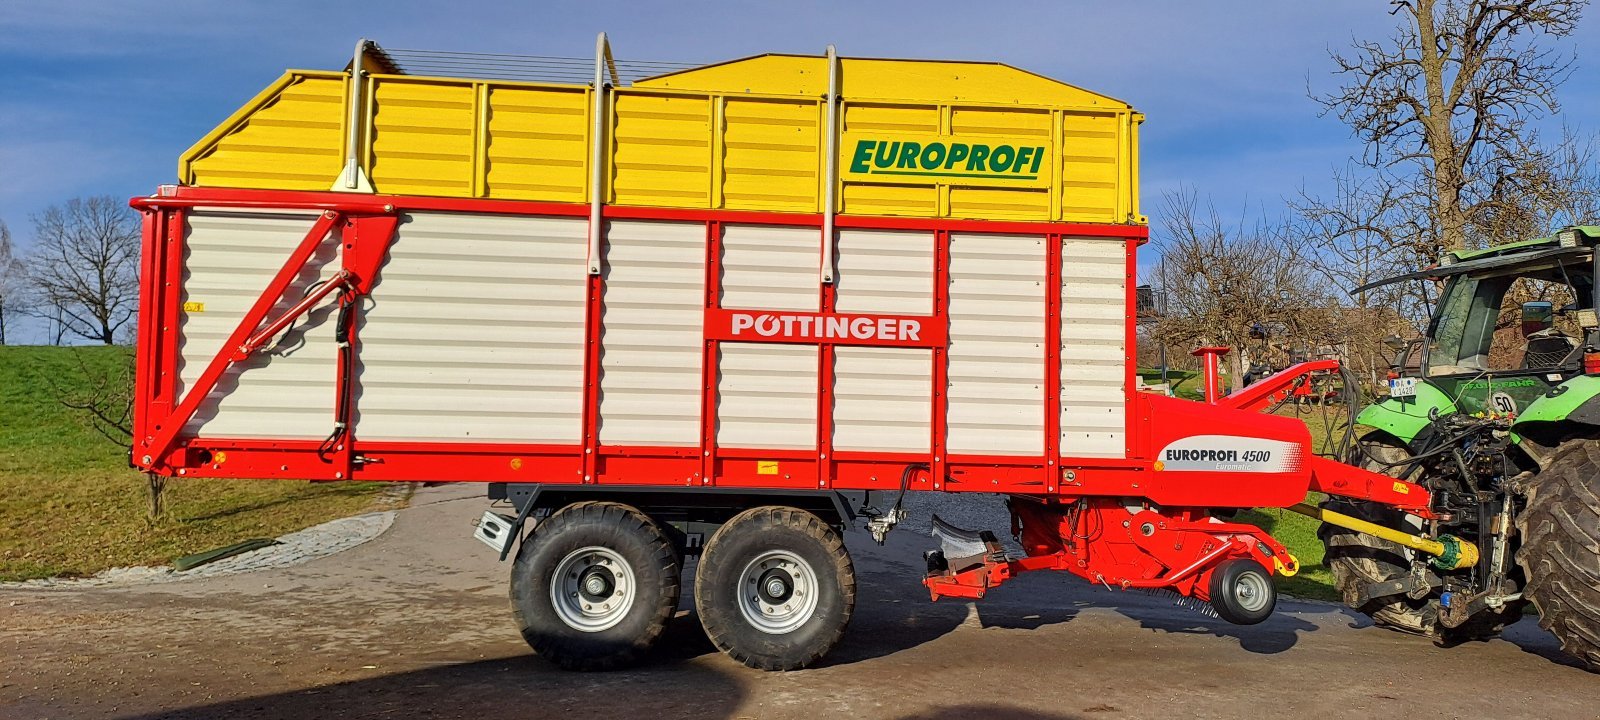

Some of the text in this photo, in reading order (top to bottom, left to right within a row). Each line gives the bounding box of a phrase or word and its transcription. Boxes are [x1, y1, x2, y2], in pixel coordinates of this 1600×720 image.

[849, 139, 1045, 174] EUROPROFI
[1495, 396, 1513, 412] 50
[1166, 449, 1271, 463] EUROPROFI 4500
[1215, 462, 1251, 471] Euromatic
